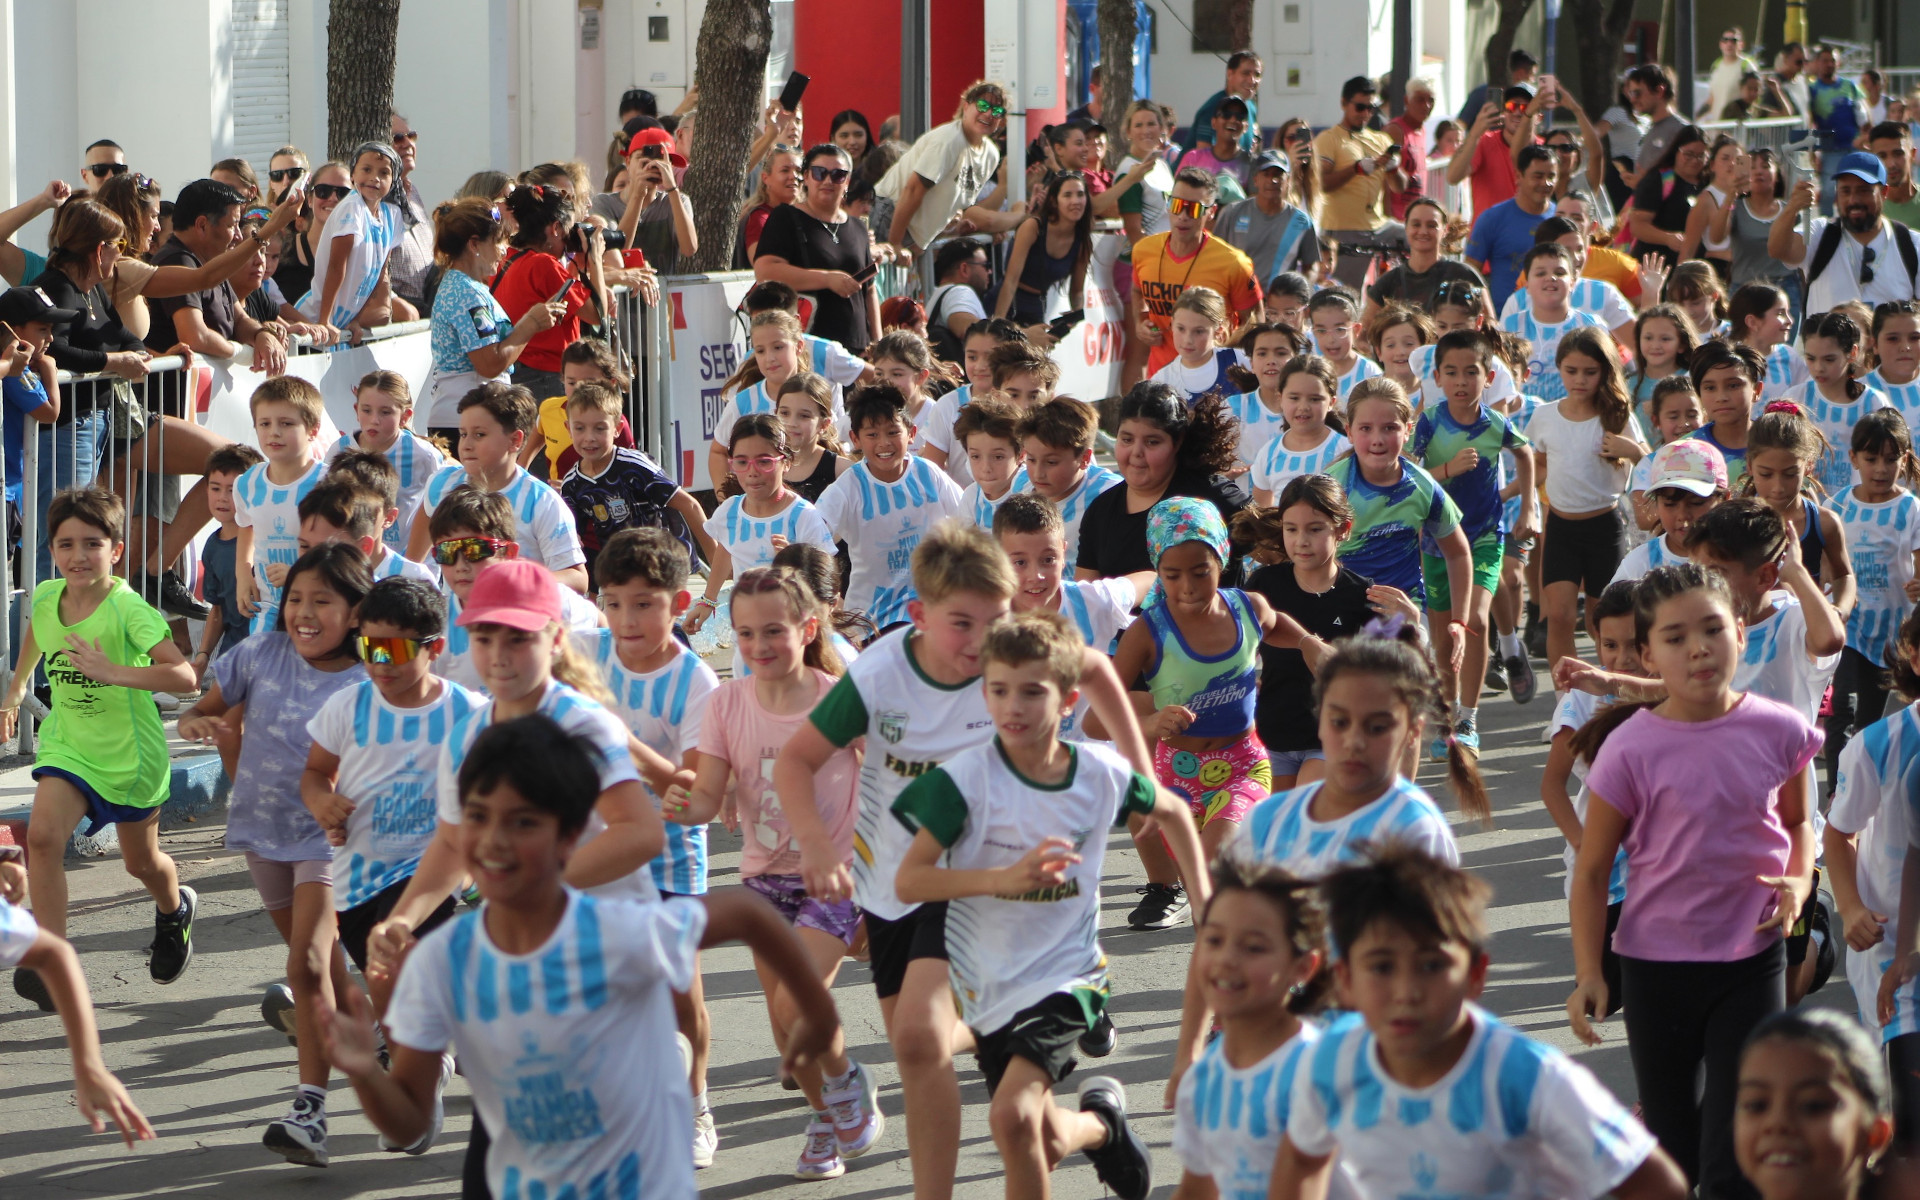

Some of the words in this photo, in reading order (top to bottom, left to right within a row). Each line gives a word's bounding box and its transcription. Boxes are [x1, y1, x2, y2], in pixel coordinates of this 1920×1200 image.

[1142, 280, 1183, 302] OCHO
[1192, 687, 1226, 702] ESCUELA
[1227, 683, 1238, 693] DE
[392, 782, 424, 799] MINI
[373, 794, 437, 819] APAMPA
[372, 815, 436, 835] TRAVIESA
